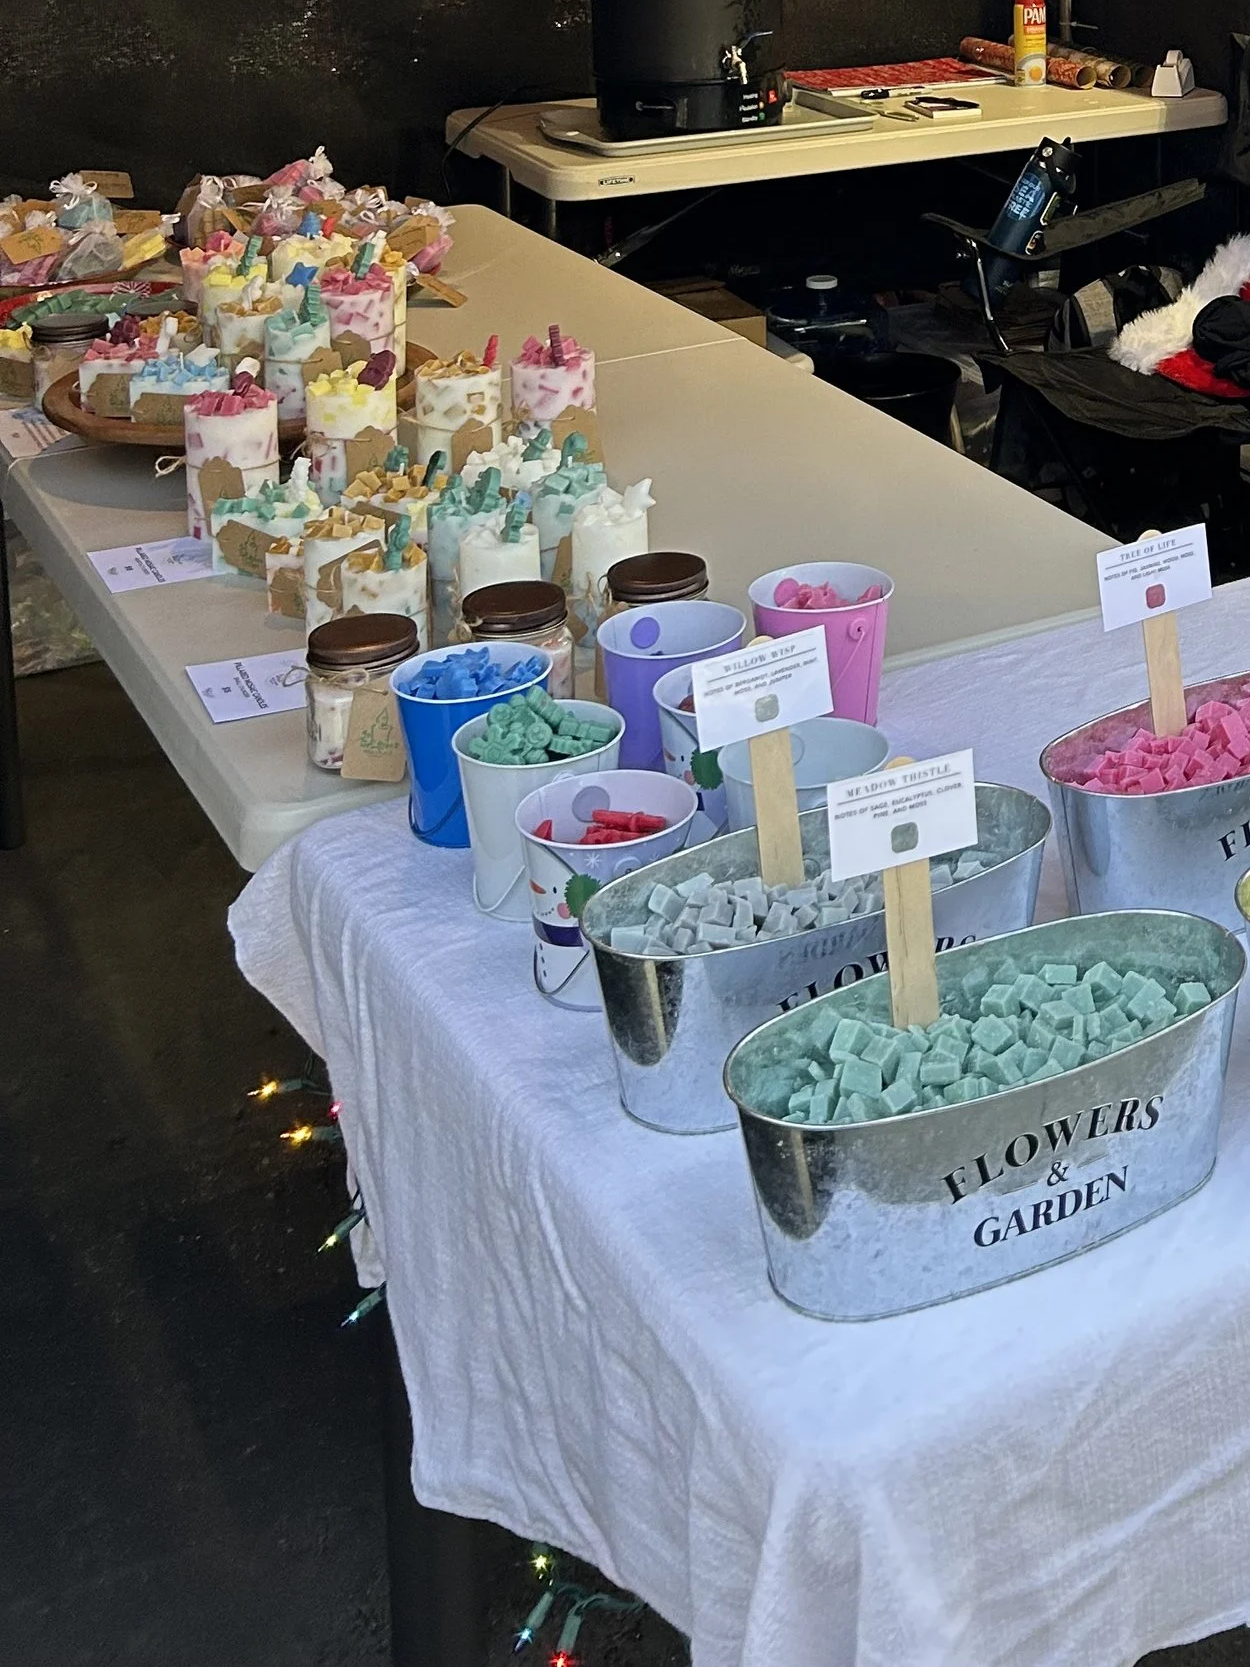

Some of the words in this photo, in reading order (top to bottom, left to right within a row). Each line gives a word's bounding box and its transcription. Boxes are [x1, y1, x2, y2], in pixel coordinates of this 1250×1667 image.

[1120, 548, 1140, 562] TREE
[1144, 545, 1155, 554] OF
[1158, 538, 1176, 550] LIFE
[724, 653, 767, 673] WILLOW
[770, 644, 796, 659] WISP
[846, 778, 898, 798] MEADOW
[902, 764, 950, 784] THISTLE
[834, 810, 857, 820] NOTES
[892, 806, 908, 814] AND
[942, 1094, 1164, 1204] FLOWERS
[1046, 1159, 1070, 1187] &
[974, 1164, 1129, 1248] GARDEN
